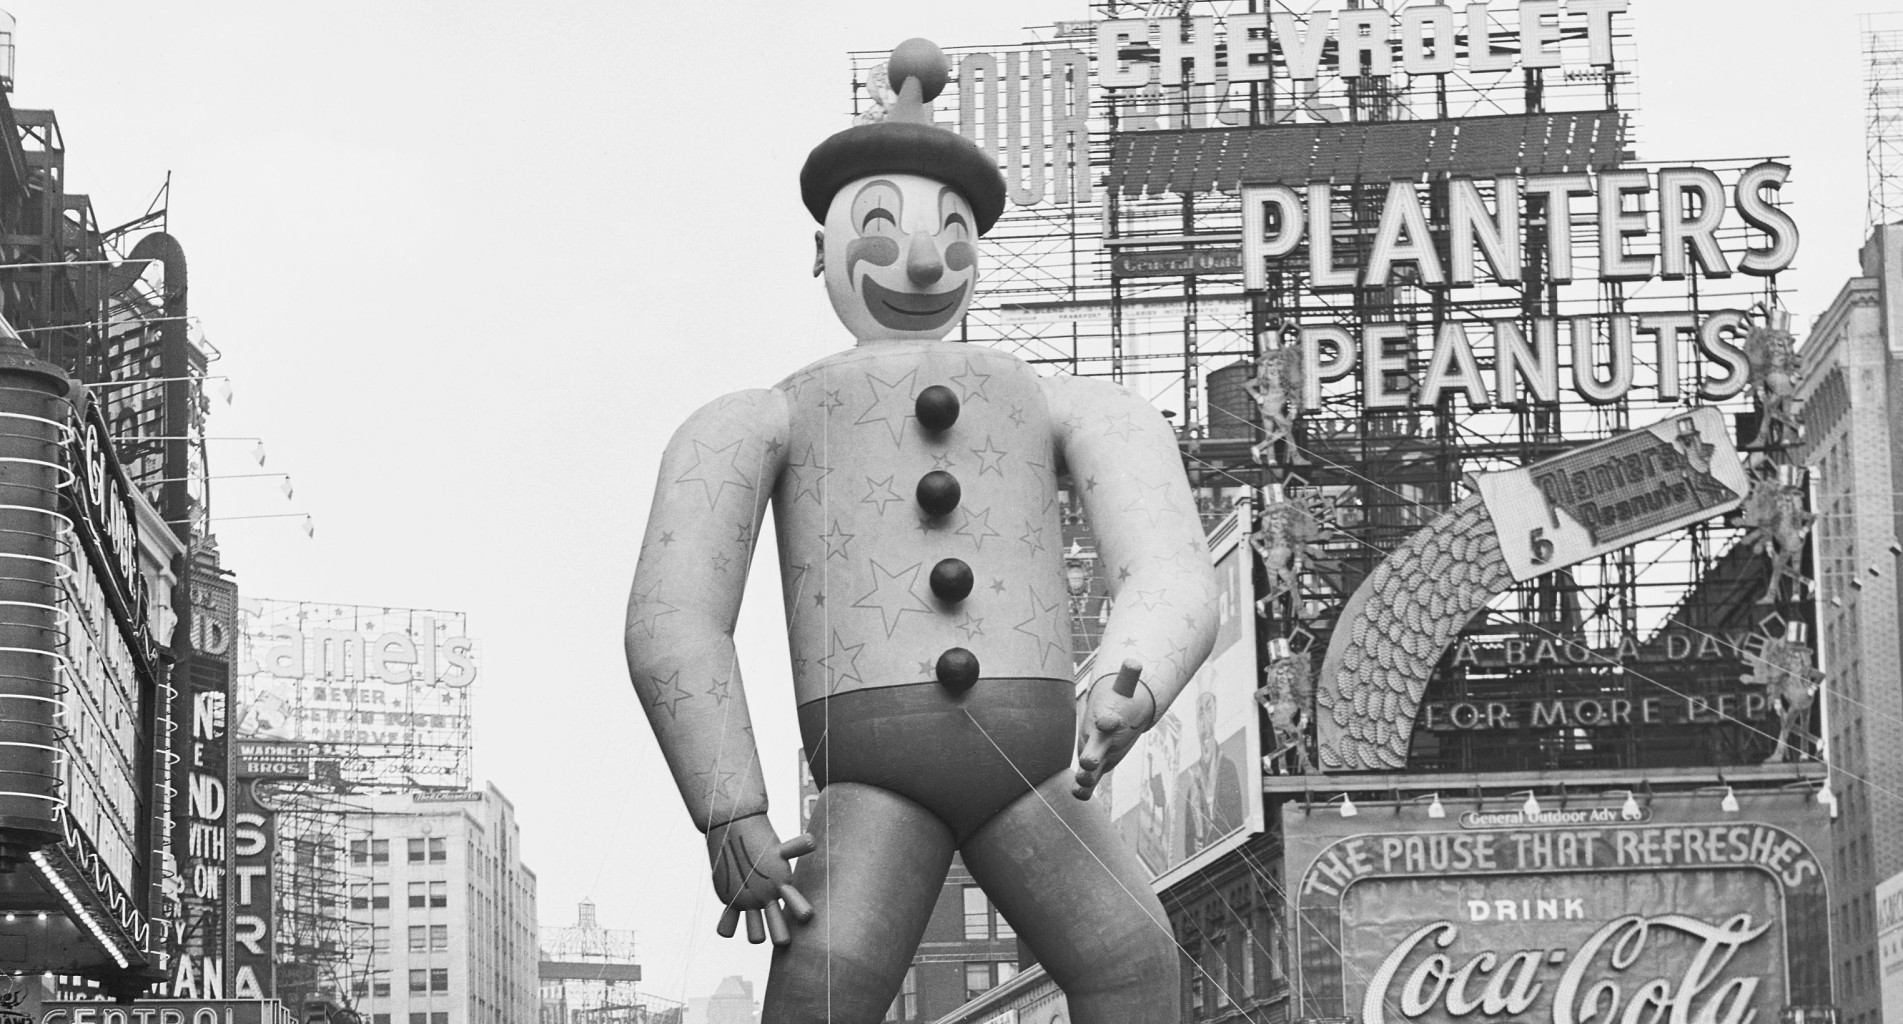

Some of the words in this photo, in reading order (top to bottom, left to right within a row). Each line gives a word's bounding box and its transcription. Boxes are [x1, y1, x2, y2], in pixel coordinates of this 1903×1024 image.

[1098, 1, 1628, 88] CHEVROLET
[957, 48, 1093, 206] OUR
[1241, 160, 1799, 291] PLANTERS
[1123, 256, 1195, 272] General
[1301, 309, 1751, 414] PEANUTS
[1529, 526, 1555, 566] 5
[1451, 640, 1479, 667] A
[1505, 638, 1591, 665] BAG
[1615, 636, 1641, 662] A
[1425, 701, 1512, 730] FOR
[1530, 698, 1661, 727] MORE
[1687, 693, 1767, 722] PEP
[1469, 811, 1524, 825] General
[1530, 810, 1586, 824] Outdoor
[1589, 808, 1617, 822] Adv
[1303, 839, 1373, 896] THE
[1383, 834, 1497, 872] PAUSE
[1510, 832, 1601, 869] THAT
[1616, 827, 1817, 887] REFRESHES
[1468, 898, 1585, 922] DRINK
